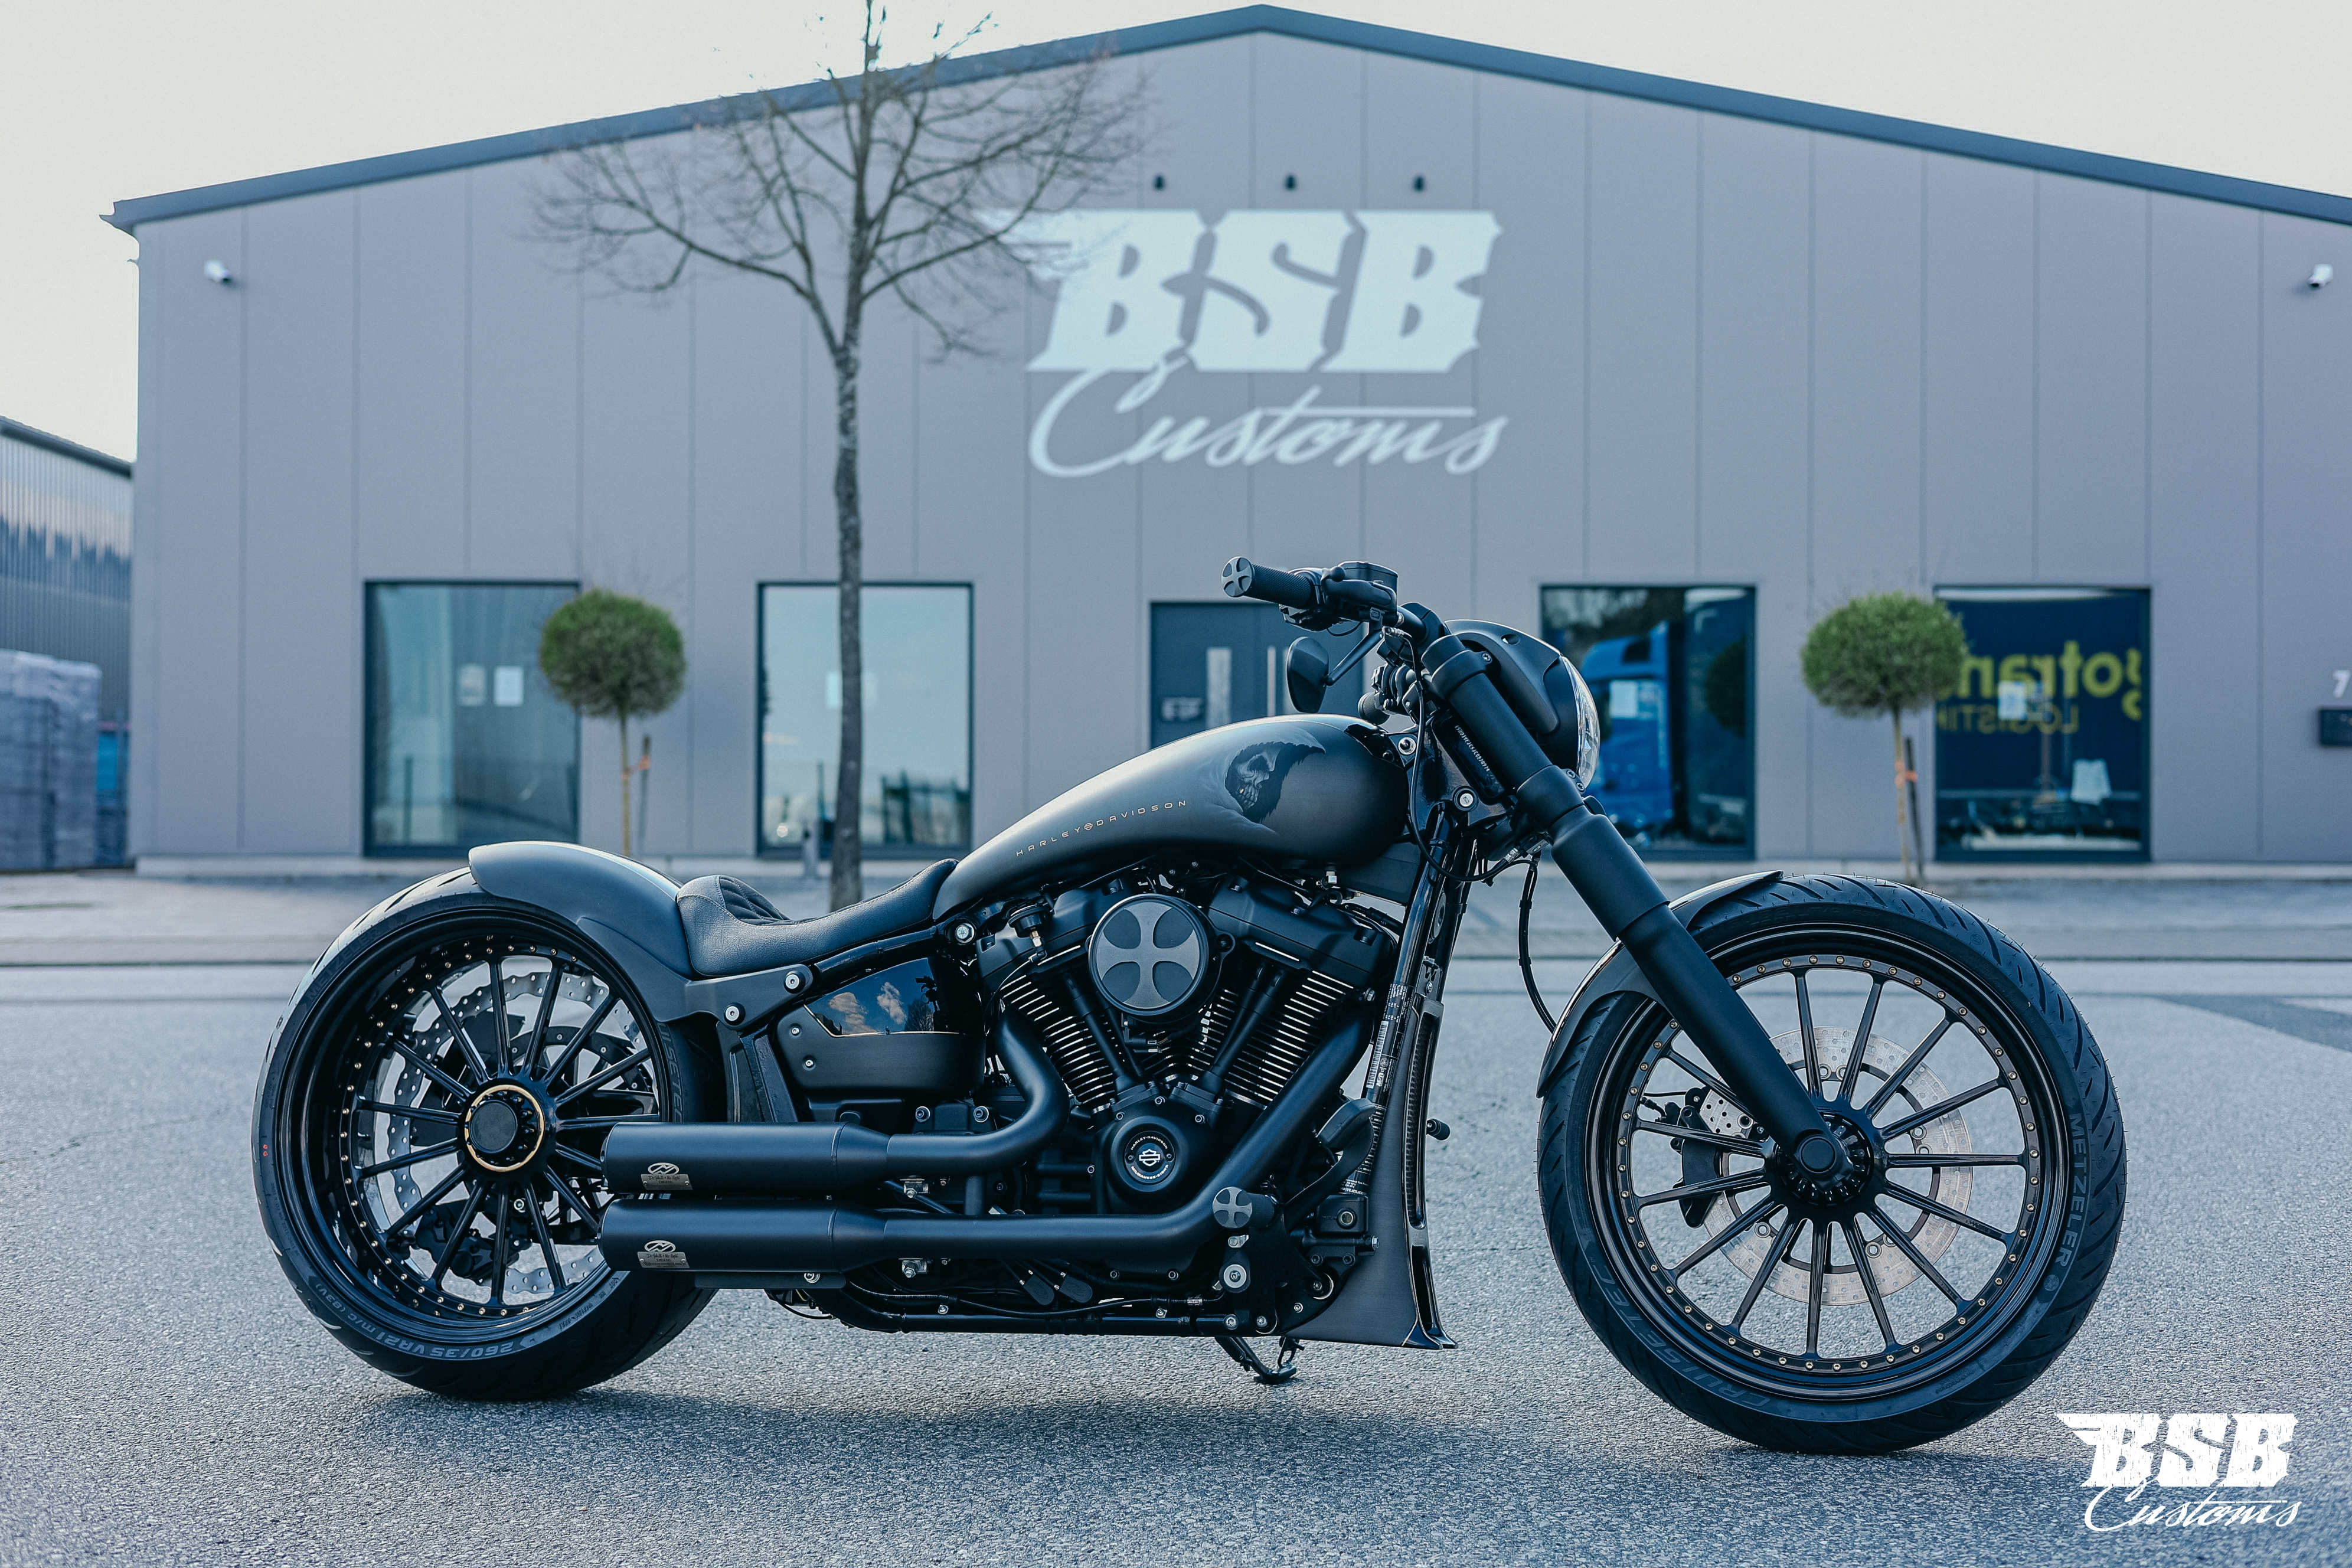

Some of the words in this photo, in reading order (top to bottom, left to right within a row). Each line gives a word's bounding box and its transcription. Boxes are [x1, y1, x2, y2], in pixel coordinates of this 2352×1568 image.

[982, 209, 1503, 373] BSB
[1028, 349, 1509, 478] Customs
[2333, 669, 2351, 698] 7
[1015, 827, 1081, 857] HARLEY
[1096, 799, 1186, 827] DAVIDSON
[657, 1023, 683, 1122] UISETEC
[2054, 1113, 2088, 1267] METZELER
[314, 1282, 347, 1315] (83V)
[1592, 1264, 1770, 1407] CRUISETEC
[429, 1341, 514, 1359] 260/35
